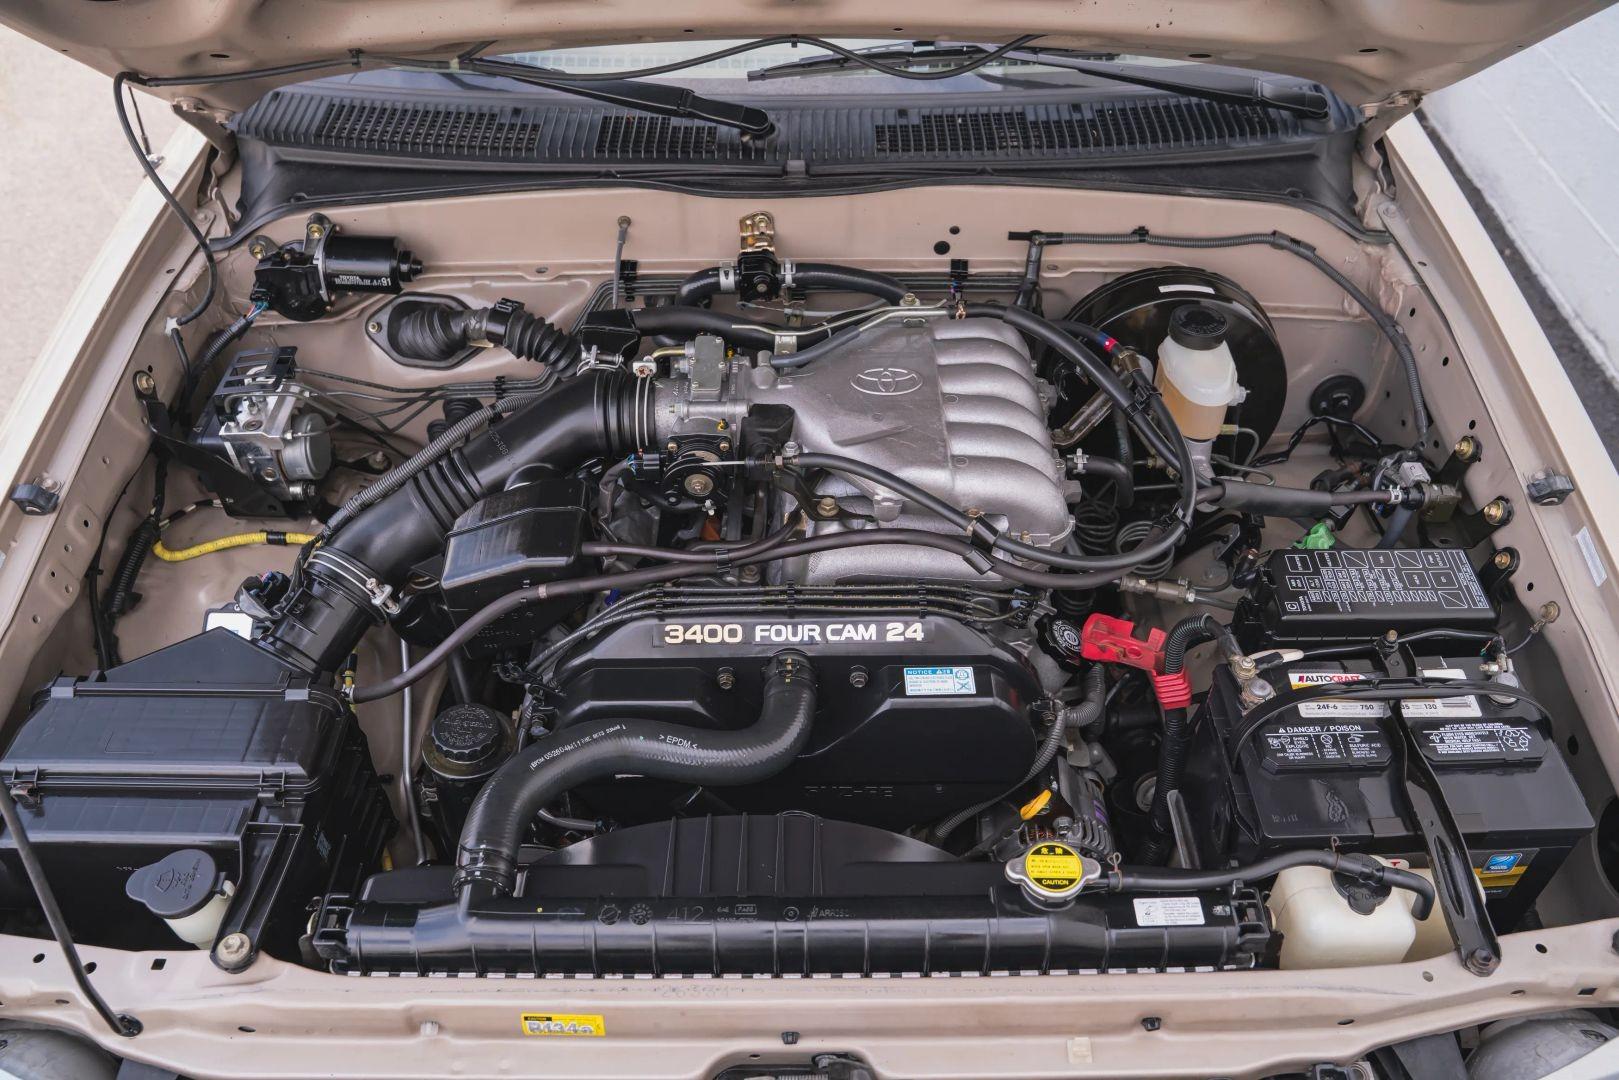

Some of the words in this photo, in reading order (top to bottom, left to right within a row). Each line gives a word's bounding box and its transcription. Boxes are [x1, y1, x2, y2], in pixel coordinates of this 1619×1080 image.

[664, 624, 742, 644] 3400
[754, 624, 821, 642] FOUR
[826, 623, 876, 641] CAM
[886, 622, 925, 642] 24
[1306, 675, 1360, 684] AUTOCRAFT
